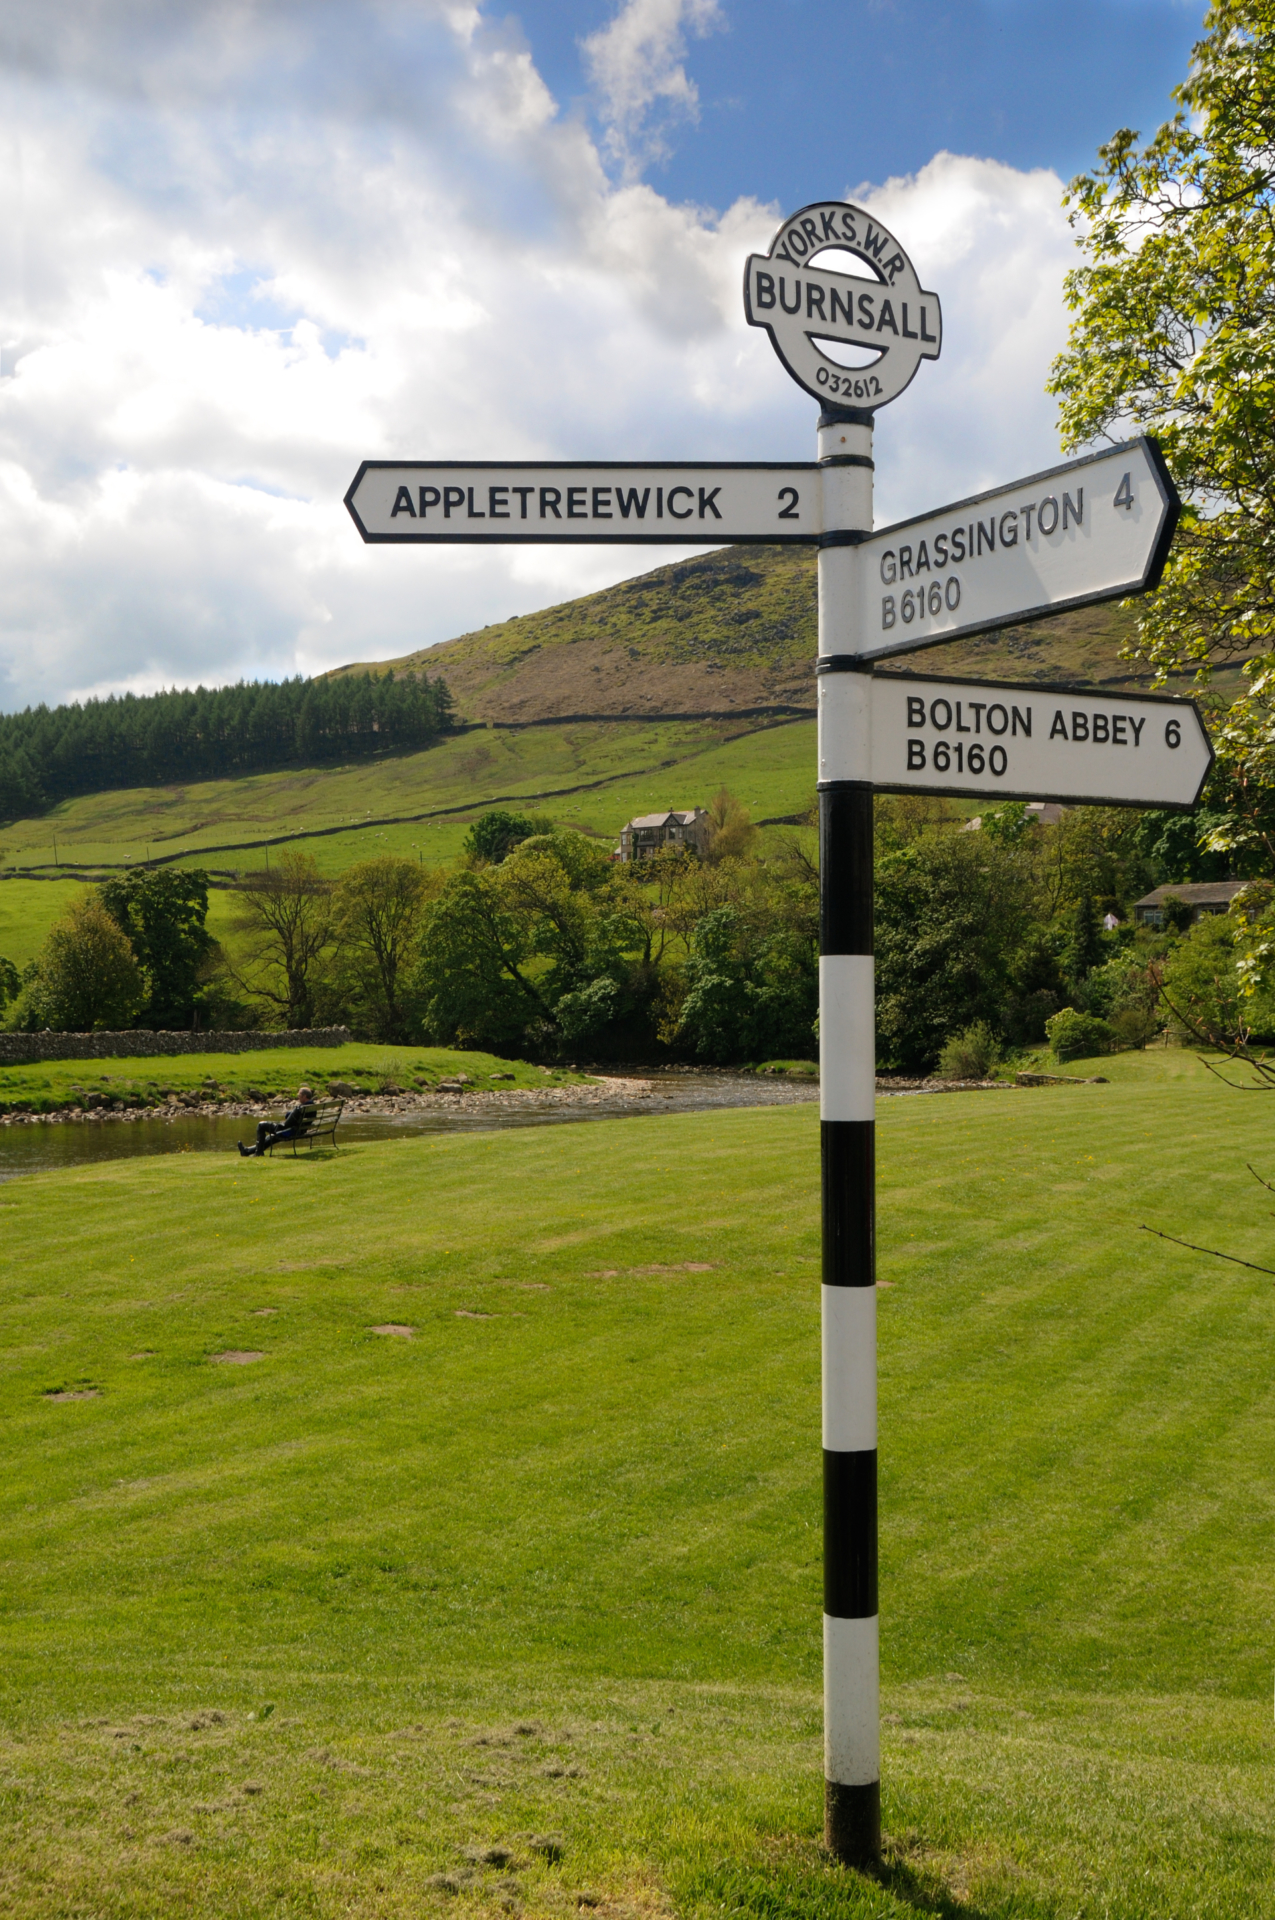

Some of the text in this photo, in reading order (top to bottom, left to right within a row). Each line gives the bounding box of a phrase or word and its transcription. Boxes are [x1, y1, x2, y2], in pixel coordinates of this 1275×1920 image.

[756, 271, 937, 343] BURNSALL
[816, 367, 884, 398] 032612
[390, 485, 800, 520] APPLETREEWICK 2
[880, 472, 1135, 585] GRASSINGTON 4
[882, 576, 961, 630] B6160
[906, 696, 1182, 749] BOLTON ABBEY 6
[906, 739, 1008, 776] B6160
